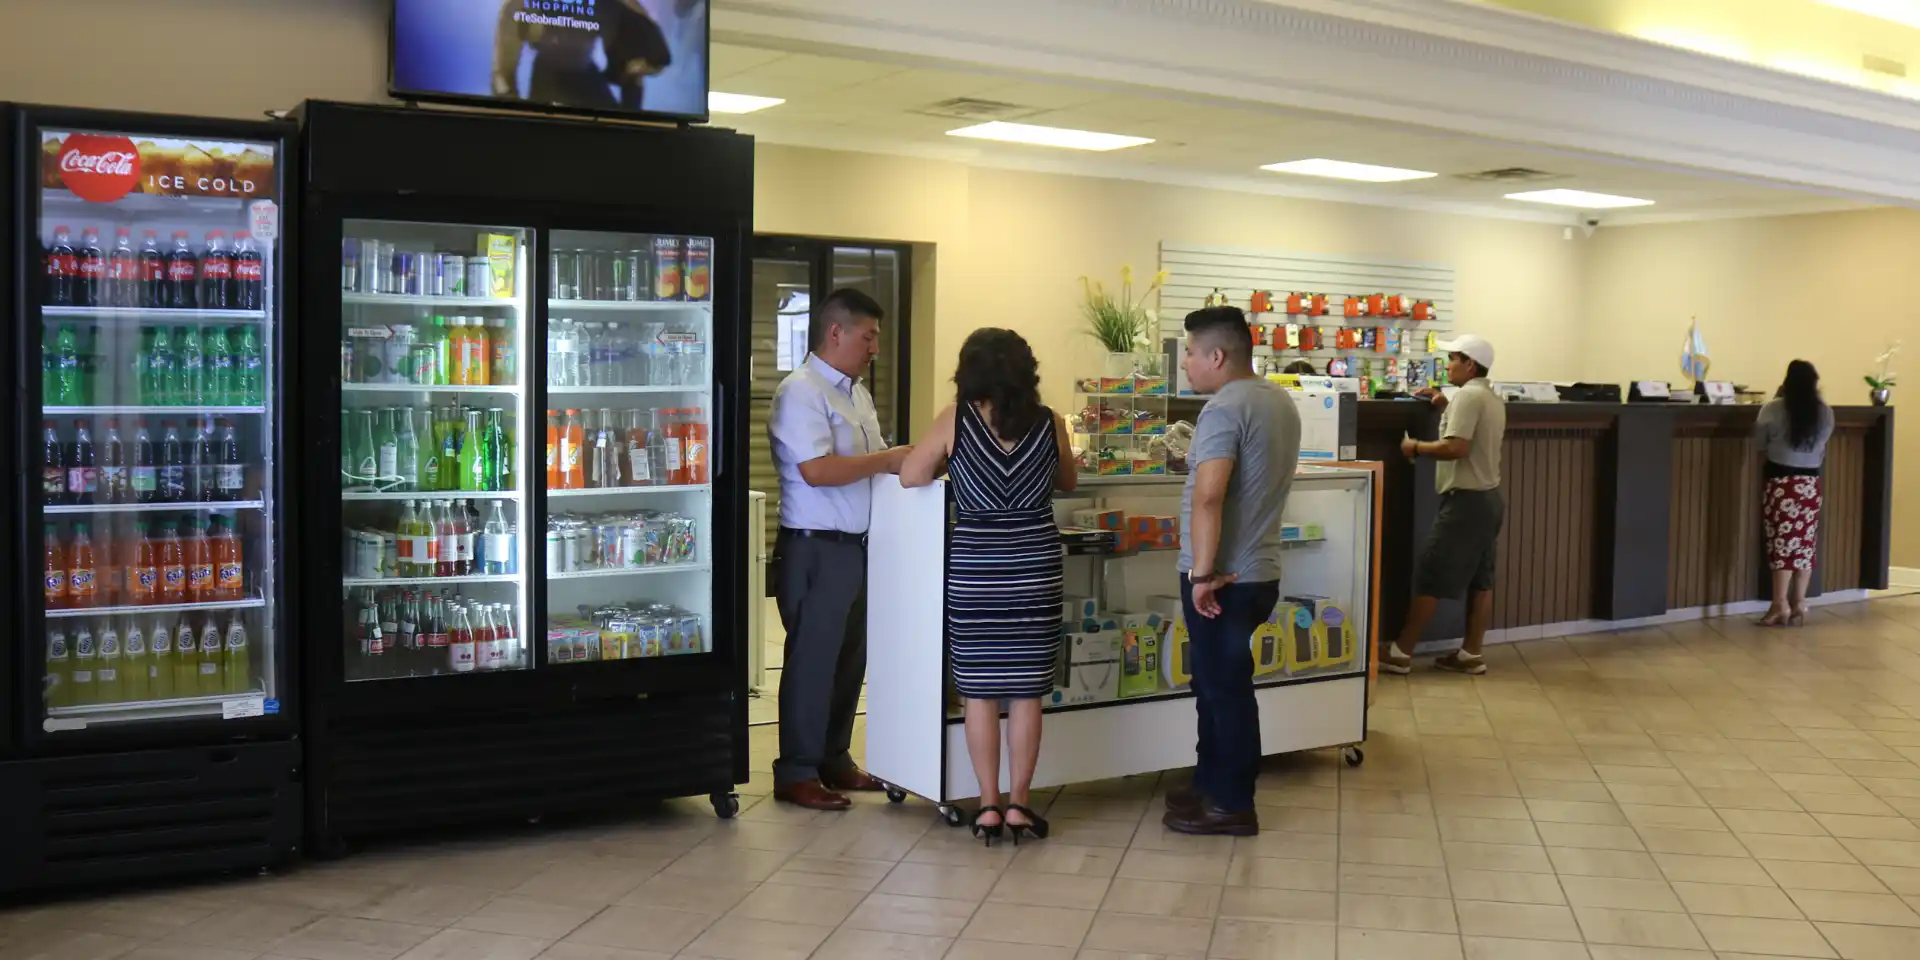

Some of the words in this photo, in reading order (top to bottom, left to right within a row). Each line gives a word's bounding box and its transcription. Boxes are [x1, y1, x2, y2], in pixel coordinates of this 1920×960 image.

[523, 0, 595, 16] SHOPPING
[513, 11, 600, 31] #TeSobraElTiempo
[61, 149, 136, 176] Coca-Cola
[149, 175, 185, 190] ICE
[197, 177, 255, 193] COLD
